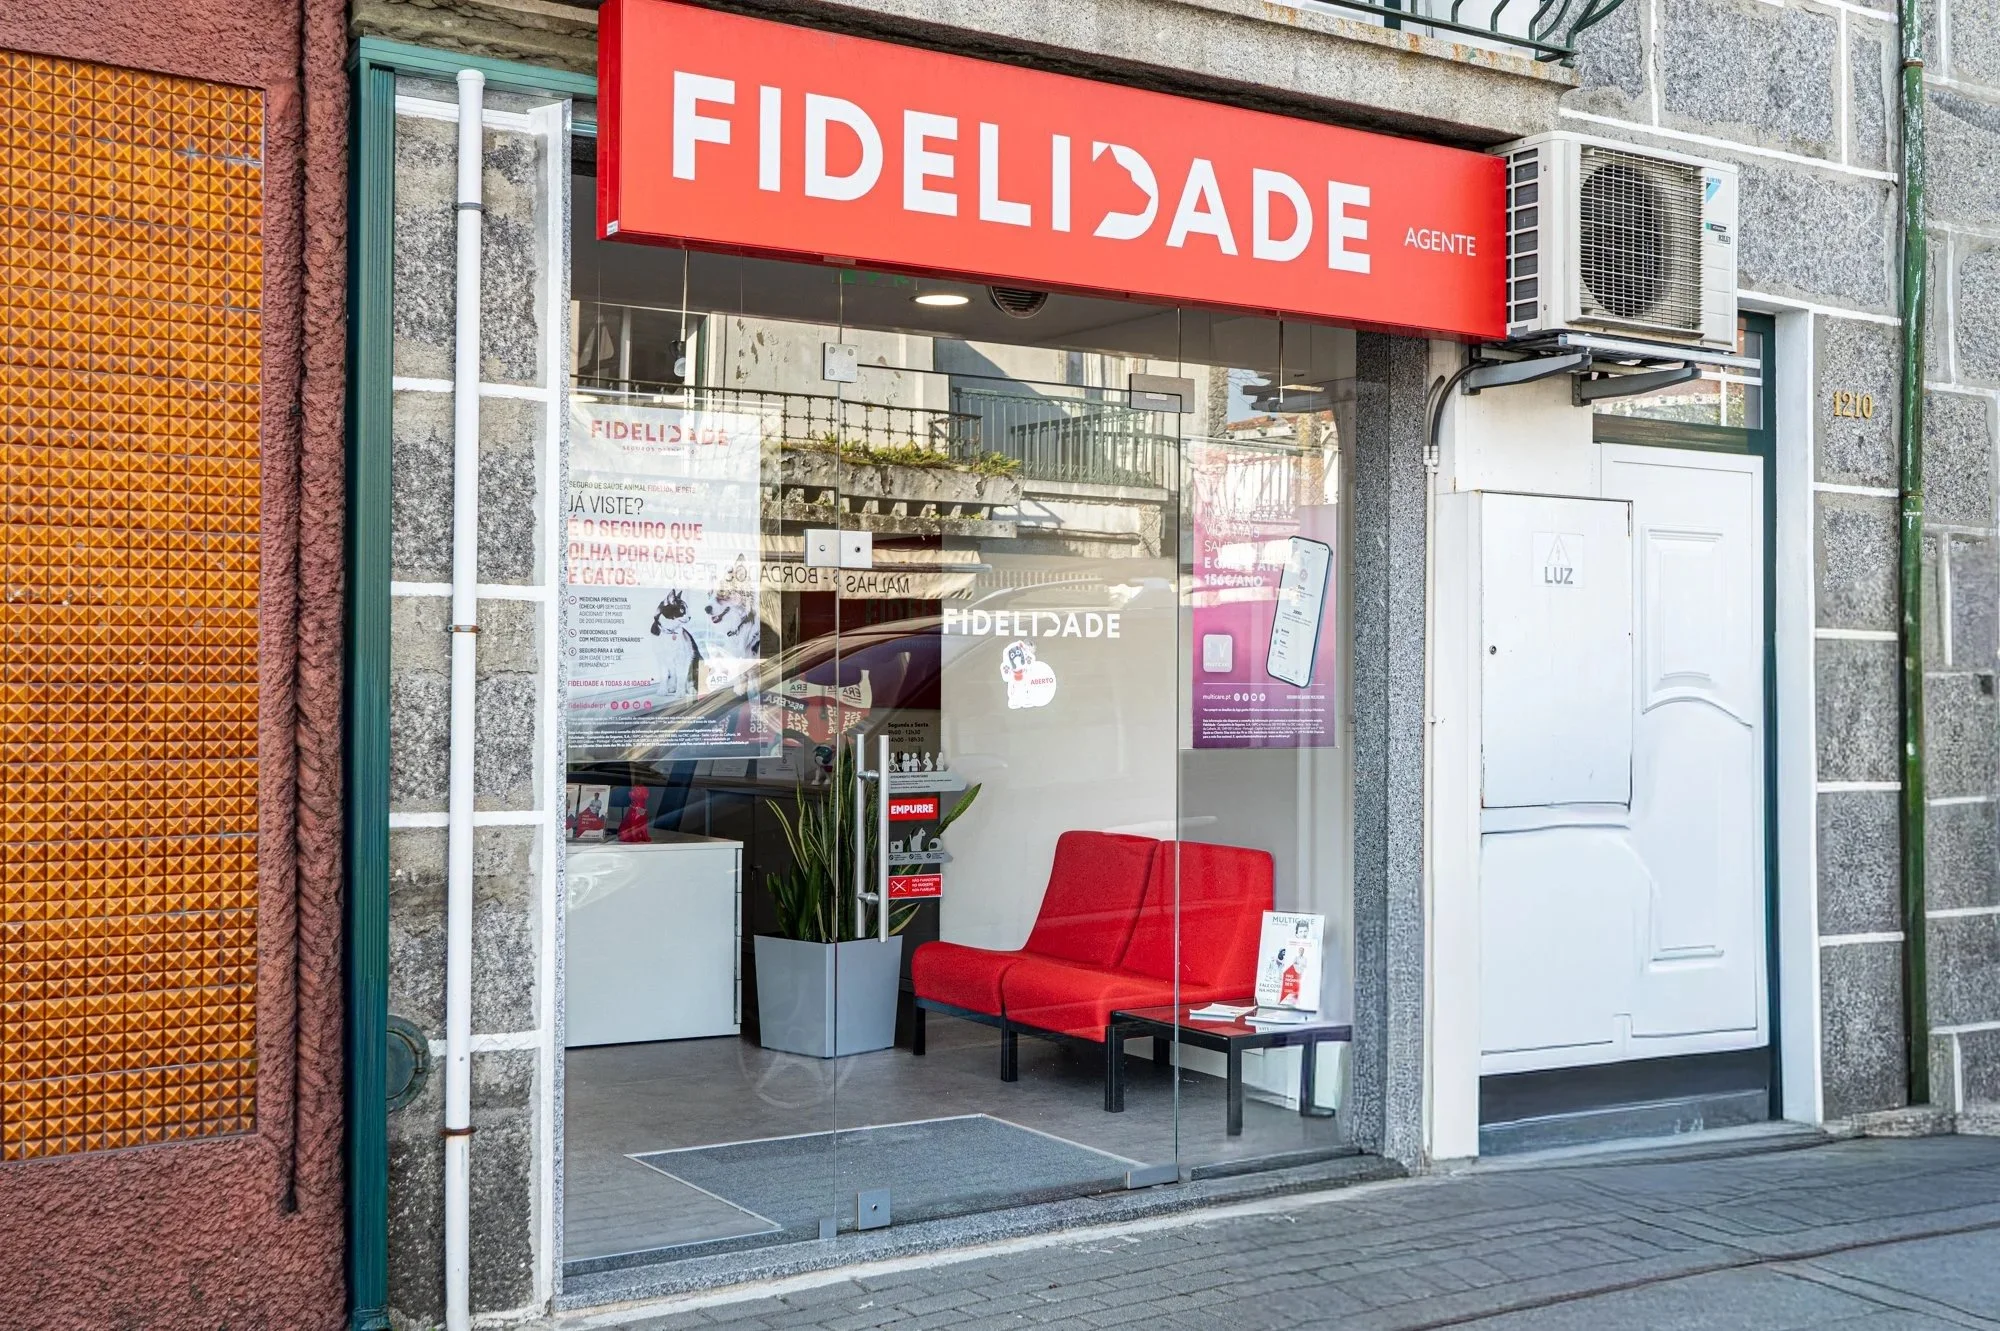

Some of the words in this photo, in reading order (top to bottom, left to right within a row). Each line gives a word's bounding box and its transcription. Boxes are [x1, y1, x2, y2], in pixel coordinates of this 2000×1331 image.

[673, 70, 1371, 275] FIDELIDADE
[1404, 227, 1477, 258] AGENTE
[1833, 391, 1873, 419] 1210
[591, 419, 729, 447] FIDELIDADE
[568, 481, 593, 489] SEGURO
[624, 483, 647, 492] ANIMAL
[568, 489, 585, 513] JÁ
[590, 494, 644, 515] VISTE?
[567, 514, 579, 536] É
[583, 518, 594, 537] O
[599, 519, 666, 540] SEGURO
[670, 522, 703, 544] QUE
[568, 542, 613, 561] OLHA
[617, 543, 649, 562] POR
[653, 543, 696, 564] CÃES
[567, 565, 579, 585] E
[582, 566, 641, 586] GATOS.
[1544, 566, 1574, 585] LUZ
[942, 608, 1121, 638] FIDELIDADE
[1030, 677, 1054, 685] ABERTO
[890, 804, 934, 815] EMPURRE
[1272, 916, 1315, 925] MULTICE
